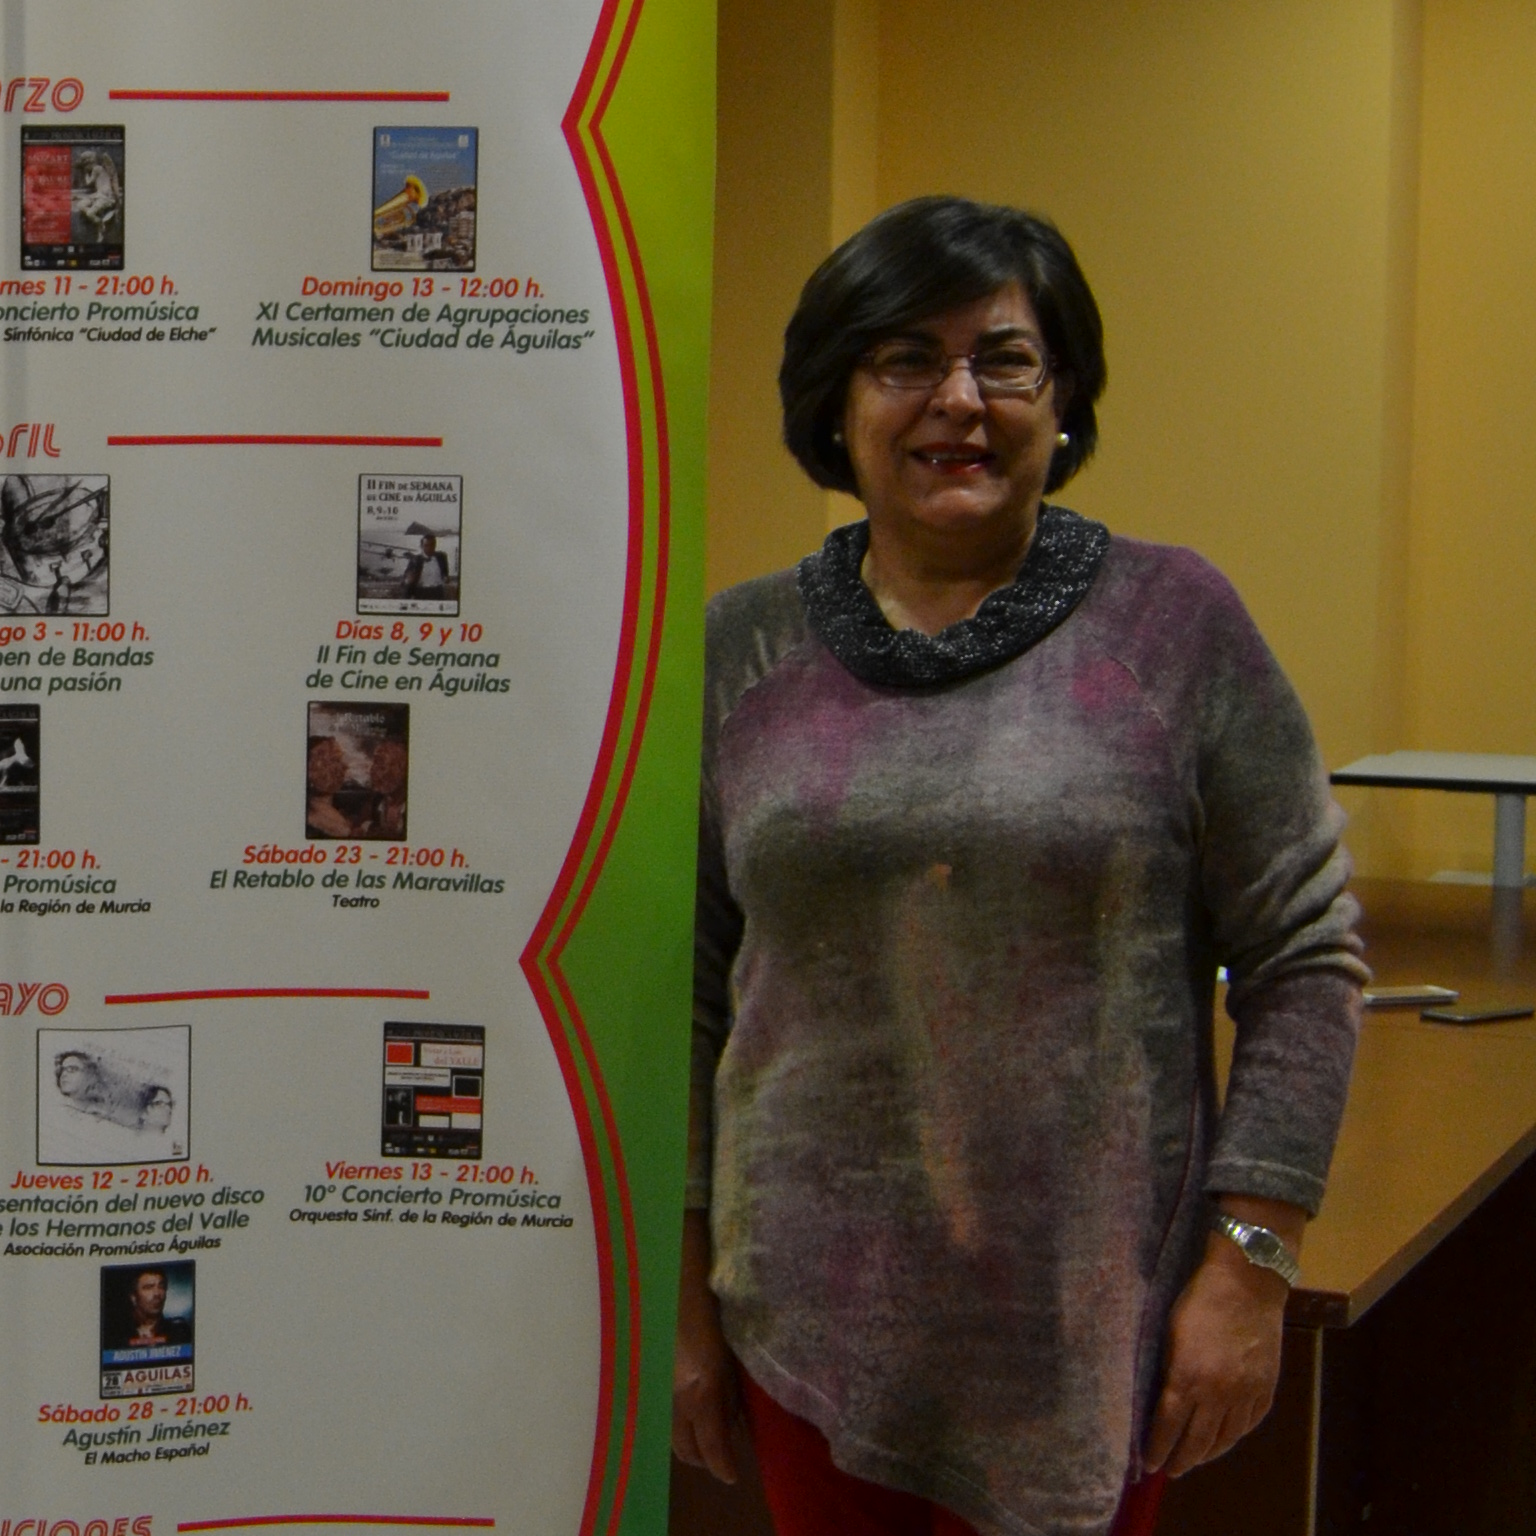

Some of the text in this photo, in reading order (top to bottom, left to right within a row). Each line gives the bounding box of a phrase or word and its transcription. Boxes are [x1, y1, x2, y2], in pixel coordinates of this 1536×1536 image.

[302, 276, 404, 302] Domingo
[413, 278, 434, 297] 13
[461, 277, 520, 298] 12:00
[525, 277, 544, 297] h.
[87, 301, 199, 321] Promúsica
[256, 302, 589, 332] XI Certamen de Agrupaciones
[3, 327, 74, 342] Sinfónica
[146, 327, 165, 341] de
[252, 327, 361, 347] Musicales
[466, 325, 494, 348] de
[38, 647, 66, 666] de
[72, 647, 154, 667] Bandas
[317, 645, 500, 667] II Fin de Semana
[0, 676, 42, 691] una
[48, 672, 121, 696] pasión
[306, 669, 511, 695] de Cine en Águilas
[3, 874, 116, 894] Promúsica
[210, 869, 505, 893] El Retablo de las Maravillas
[105, 1193, 138, 1213] del
[143, 1193, 205, 1211] nuevo
[211, 1187, 264, 1206] disco
[342, 1185, 442, 1205] Concierto
[449, 1188, 561, 1209] Promúsica
[3, 1235, 221, 1257] Asociación Promúsica Águilas
[63, 1420, 230, 1451] Agustín Jiménez
